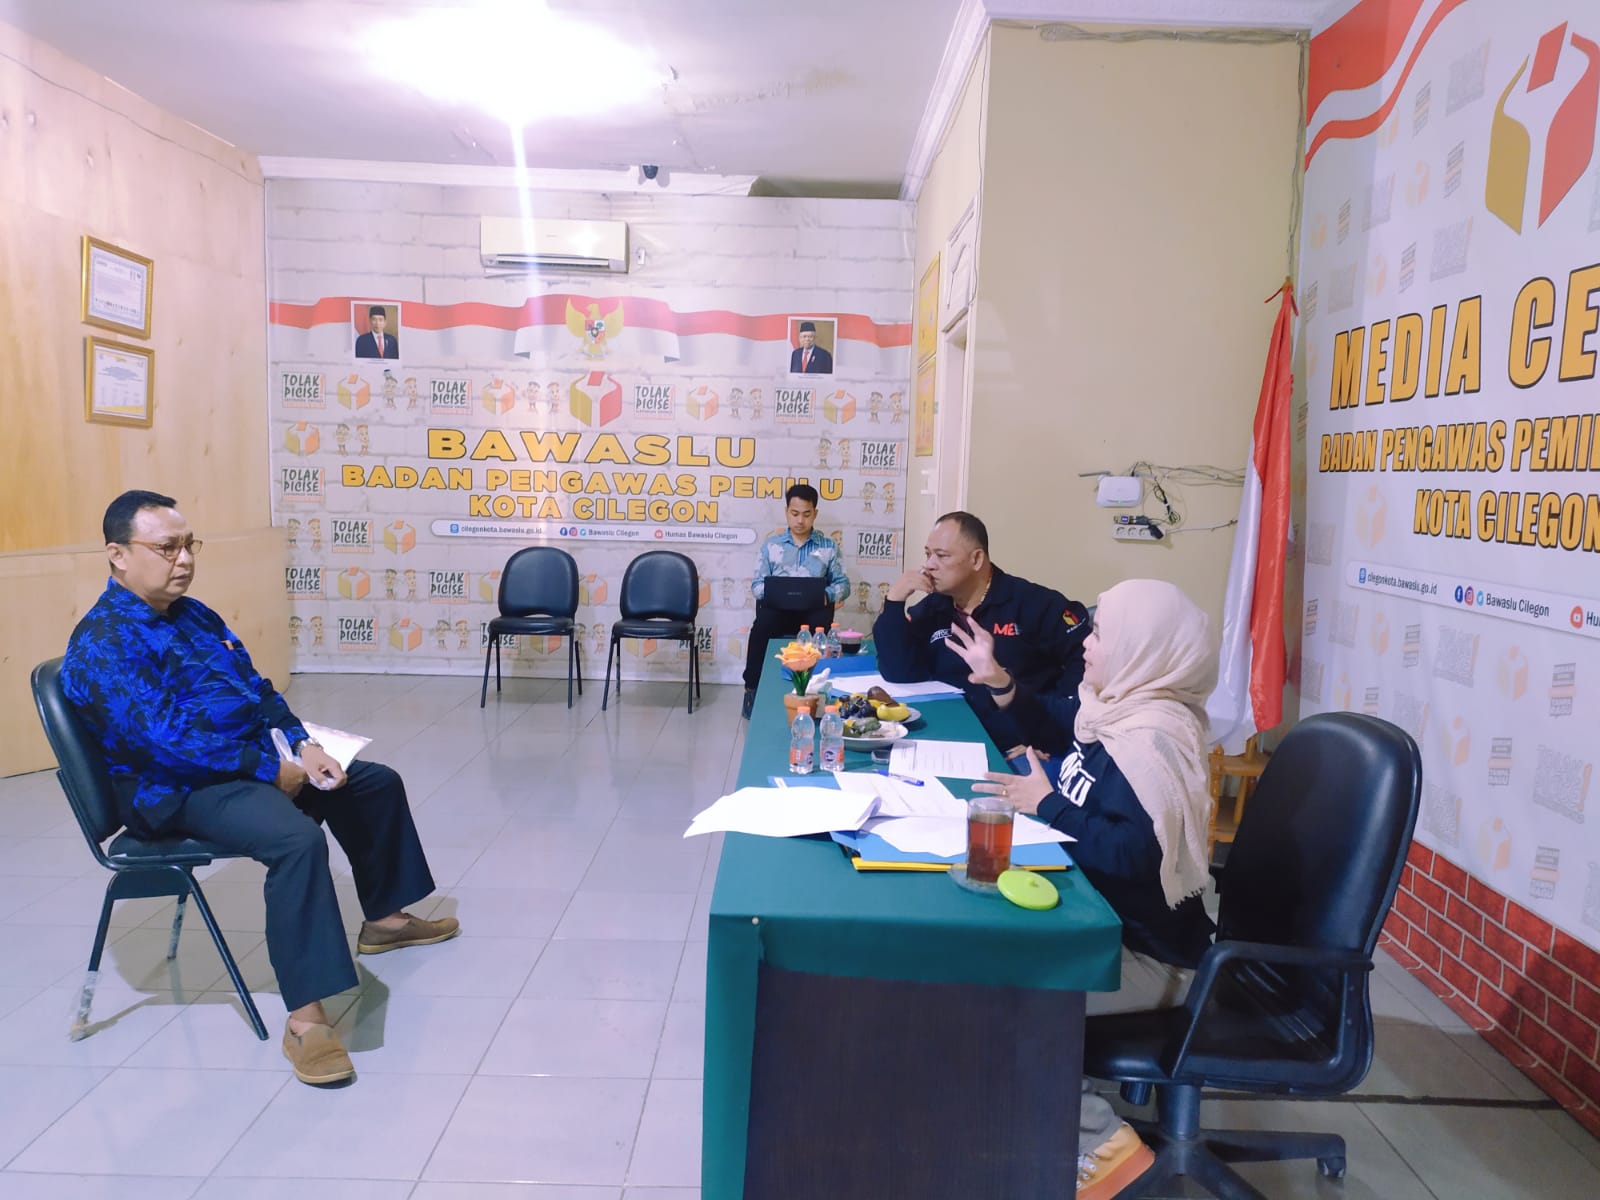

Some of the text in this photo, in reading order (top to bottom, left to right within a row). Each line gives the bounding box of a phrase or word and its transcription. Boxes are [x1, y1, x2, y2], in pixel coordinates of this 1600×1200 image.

[1330, 295, 1481, 410] MEDIA
[283, 374, 320, 387] TOLAK
[432, 381, 467, 393] TOLAK
[636, 386, 670, 398] TOLAK
[776, 390, 811, 401] TOLAK
[428, 429, 755, 468] BAWASLU
[862, 443, 896, 454] TOLAK
[1319, 430, 1378, 472] BADAN
[1380, 420, 1506, 472] PENGAWAS
[282, 468, 319, 481] TOLAK
[342, 465, 472, 490] BADAN
[486, 469, 697, 496] PENGAWAS
[470, 495, 718, 523] KOTA CILEGON
[1413, 489, 1471, 538] KOTA
[333, 520, 368, 532] TOLAK
[616, 529, 639, 537] Cilegon
[858, 533, 893, 545] TOLAK
[286, 567, 320, 579] TOLAK
[430, 572, 464, 584] TOLAK
[1486, 593, 1550, 618] Bawaslu Cilegon
[339, 618, 373, 630] TOLAK
[1586, 611, 1600, 627] Hu
